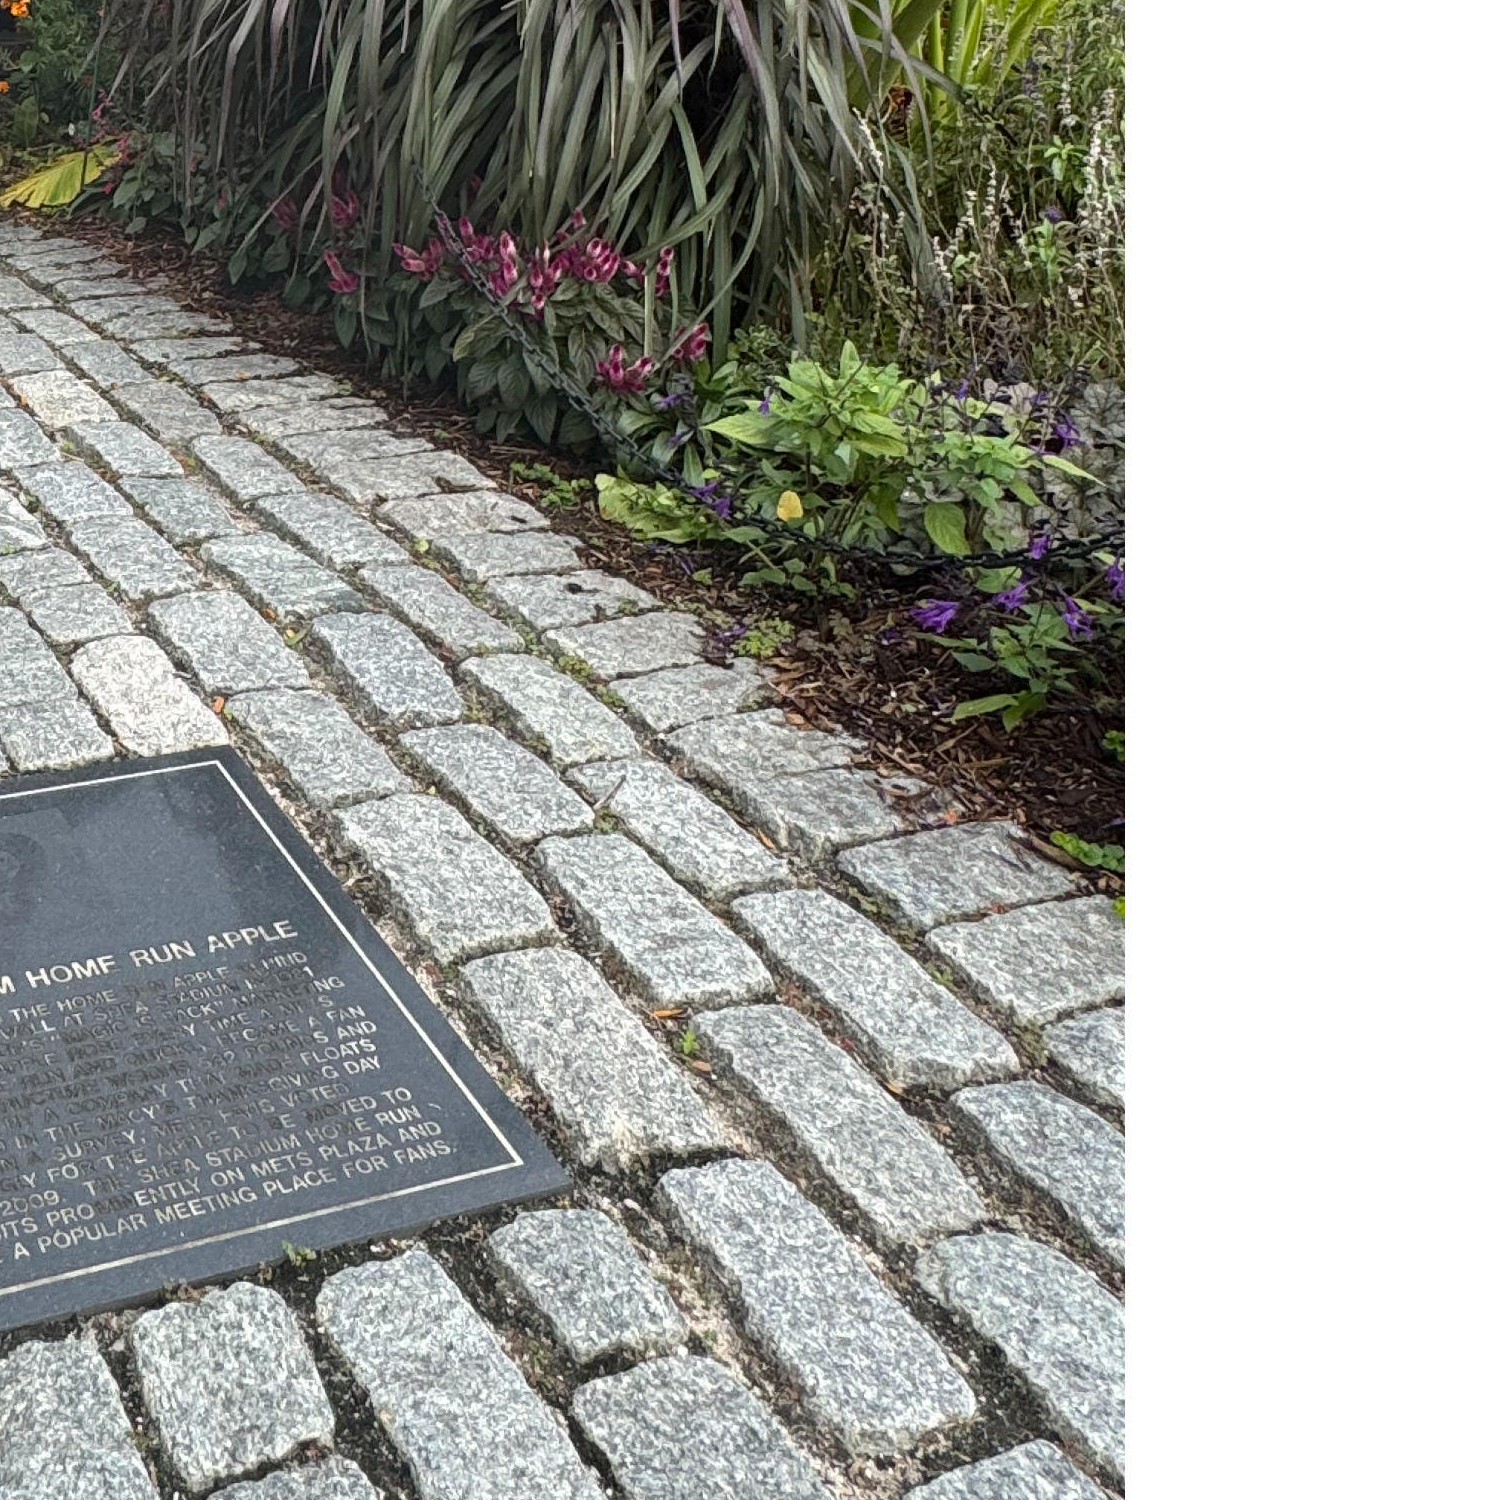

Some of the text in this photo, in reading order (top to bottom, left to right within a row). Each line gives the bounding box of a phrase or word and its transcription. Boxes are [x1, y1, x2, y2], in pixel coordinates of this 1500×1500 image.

[9, 1003, 50, 1021] THE
[57, 990, 117, 1012] HOME
[171, 967, 231, 988] APPLE
[237, 952, 308, 975] HIND
[26, 956, 119, 988] HOME
[130, 941, 195, 967] RUN
[203, 921, 297, 952] APPLE
[0, 1018, 55, 1040] WALL
[61, 1012, 86, 1027] AT
[93, 999, 148, 1021] SHEA
[154, 981, 240, 1008] STADIUM
[205, 1012, 252, 1032] TIME
[258, 1007, 273, 1020] A
[280, 995, 334, 1016] MTS
[305, 1015, 321, 1028] A
[326, 1005, 366, 1023] FAN
[334, 1020, 378, 1039] AND
[176, 1071, 229, 1093] THAT
[300, 1039, 377, 1066] FLOATS
[14, 1132, 38, 1149] IN
[44, 1120, 92, 1142] THE
[342, 1055, 383, 1074] DAY
[25, 1151, 43, 1167] A
[280, 1082, 350, 1108] VOTED
[47, 1159, 96, 1184] FOR
[103, 1148, 147, 1170] THE
[229, 1122, 261, 1141] TO
[267, 1114, 296, 1132] BE
[381, 1087, 413, 1105] TO
[46, 1176, 203, 1227] PROMINENTLY
[208, 1167, 244, 1188] ON
[250, 1150, 313, 1178] METS
[318, 1132, 391, 1161] PLAZA
[395, 1120, 443, 1143] AND
[84, 1172, 130, 1196] THE
[136, 1156, 199, 1184] SHEA
[204, 1133, 300, 1168] STADIUM
[305, 1116, 371, 1143] HOME
[375, 1105, 421, 1127] RUN
[10, 1241, 29, 1259] A
[37, 1212, 147, 1253] POPULAR
[154, 1186, 257, 1224] MEETING
[262, 1167, 336, 1197] PLACE
[340, 1154, 389, 1178] FOR
[393, 1138, 457, 1165] FANS.
